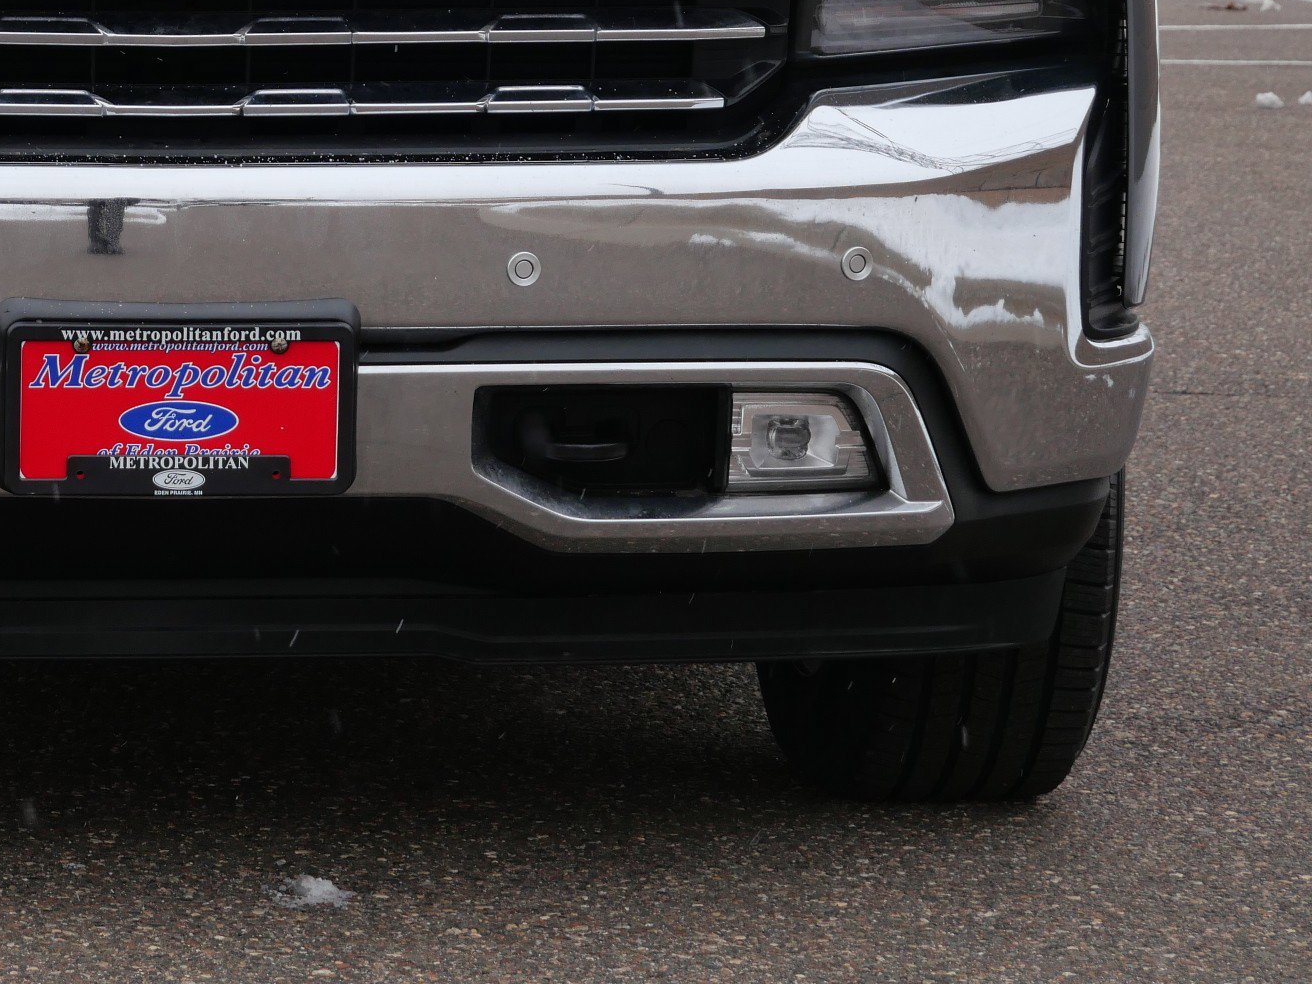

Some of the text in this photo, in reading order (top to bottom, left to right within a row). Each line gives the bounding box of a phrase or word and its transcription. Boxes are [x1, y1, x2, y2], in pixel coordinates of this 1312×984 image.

[61, 327, 302, 344] www.metropolitanford.com
[92, 341, 269, 354] www.metropolitanford.com
[29, 353, 331, 399] Metropolitan
[144, 407, 212, 432] Ford
[109, 456, 250, 469] METROPOLITAN
[164, 473, 194, 486] Ford
